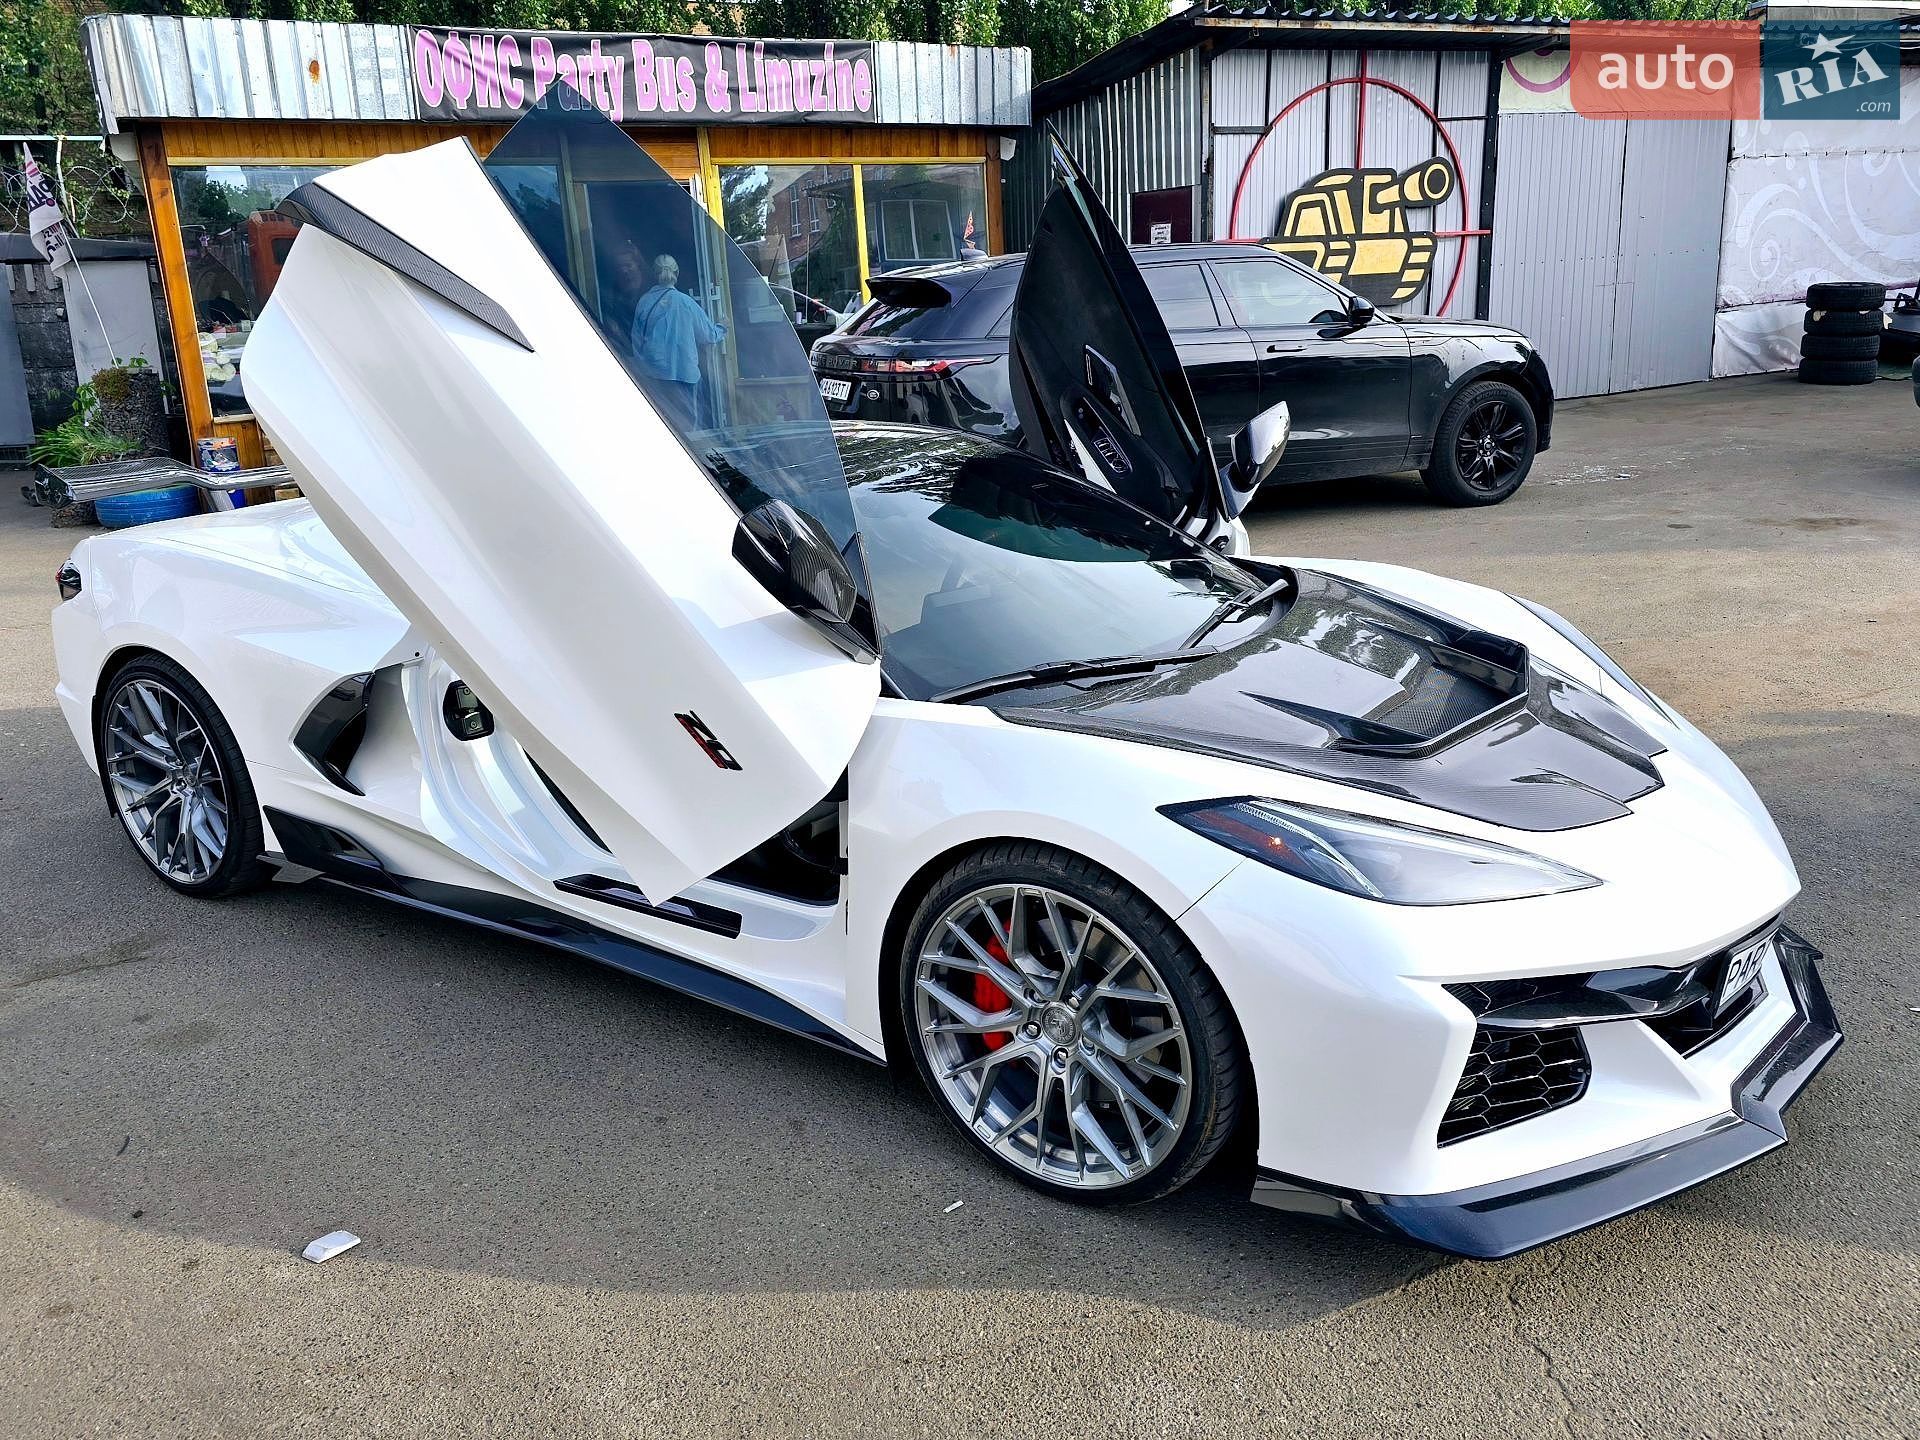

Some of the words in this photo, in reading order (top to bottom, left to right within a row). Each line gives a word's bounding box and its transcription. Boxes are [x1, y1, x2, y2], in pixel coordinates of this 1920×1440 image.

[531, 37, 625, 123] Party
[631, 39, 696, 112] Bus
[704, 42, 729, 112] &
[736, 42, 874, 113] Limuzine
